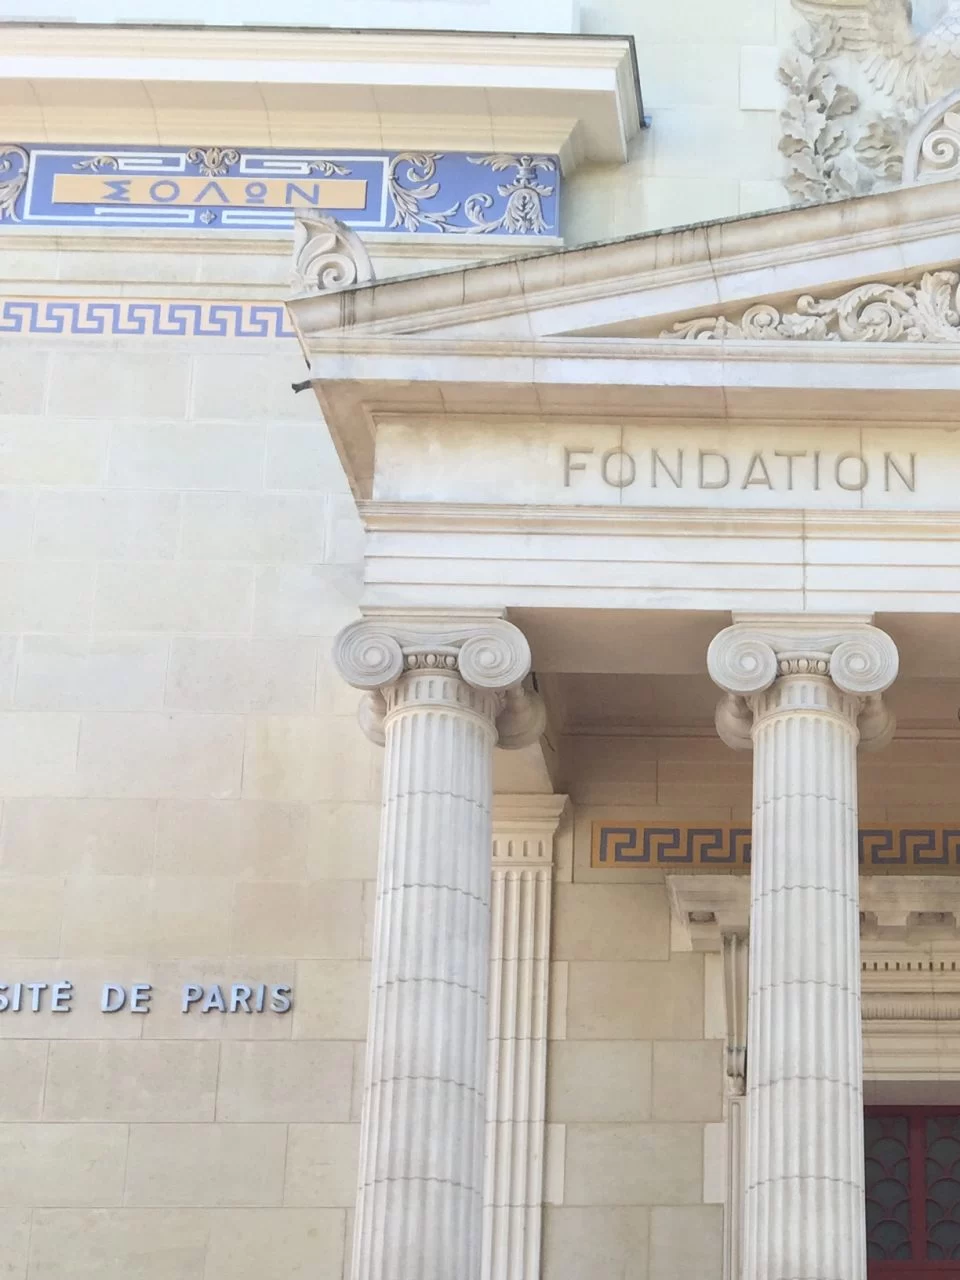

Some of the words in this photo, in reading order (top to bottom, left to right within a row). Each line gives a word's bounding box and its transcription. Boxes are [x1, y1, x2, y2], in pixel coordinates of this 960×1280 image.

[564, 446, 918, 494] FONDATION
[101, 983, 151, 1013] DE
[182, 983, 292, 1013] PARIS
